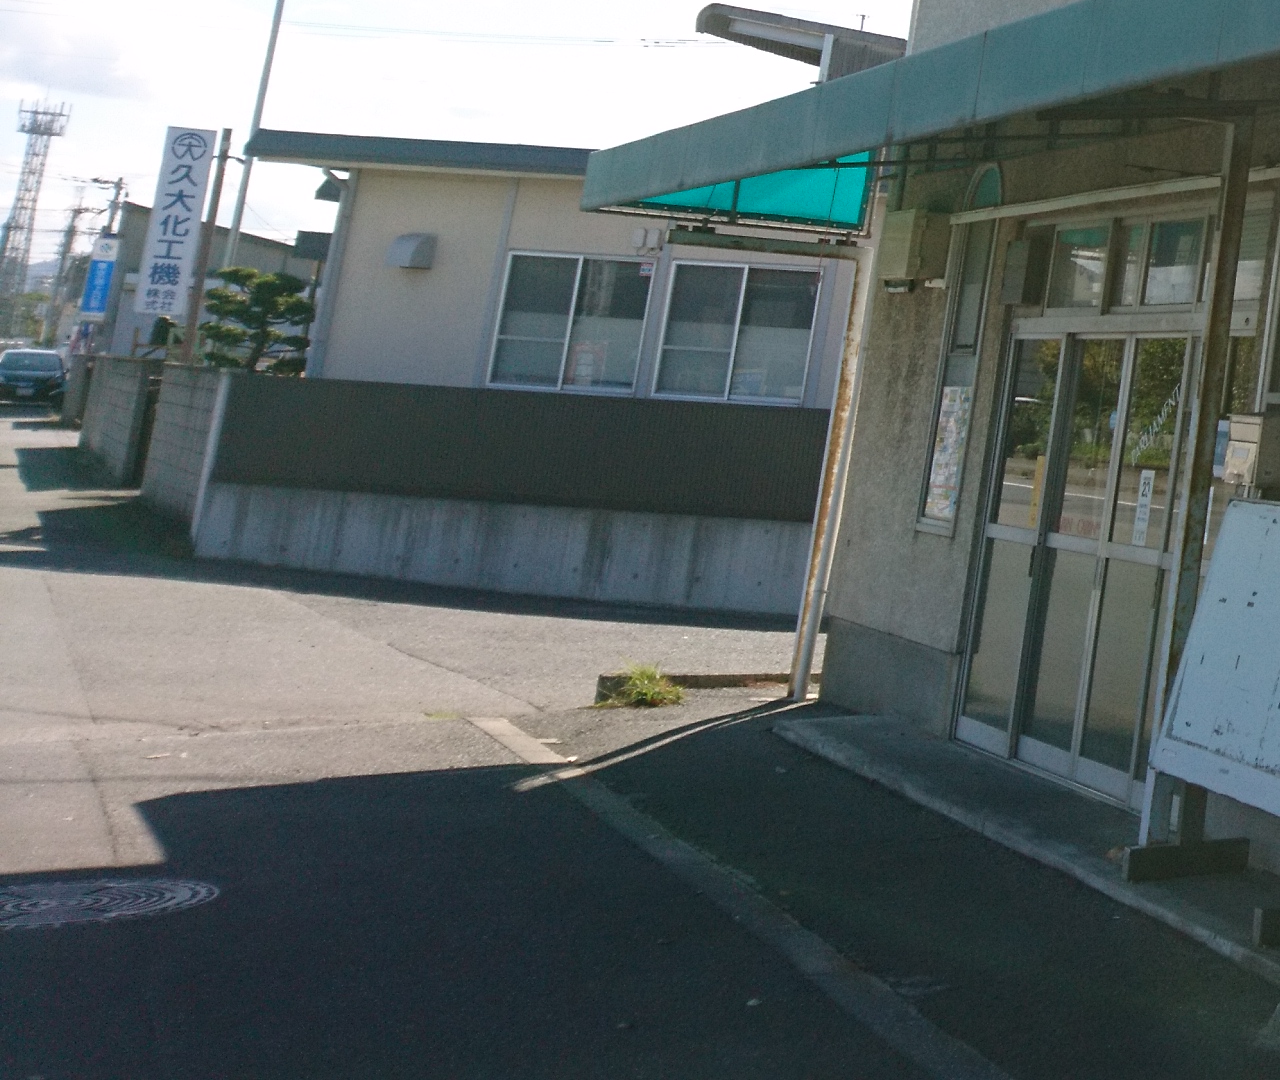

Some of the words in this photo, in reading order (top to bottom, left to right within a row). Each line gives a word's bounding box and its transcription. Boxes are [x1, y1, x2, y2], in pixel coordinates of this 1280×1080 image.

[149, 164, 198, 286] 久大化工機
